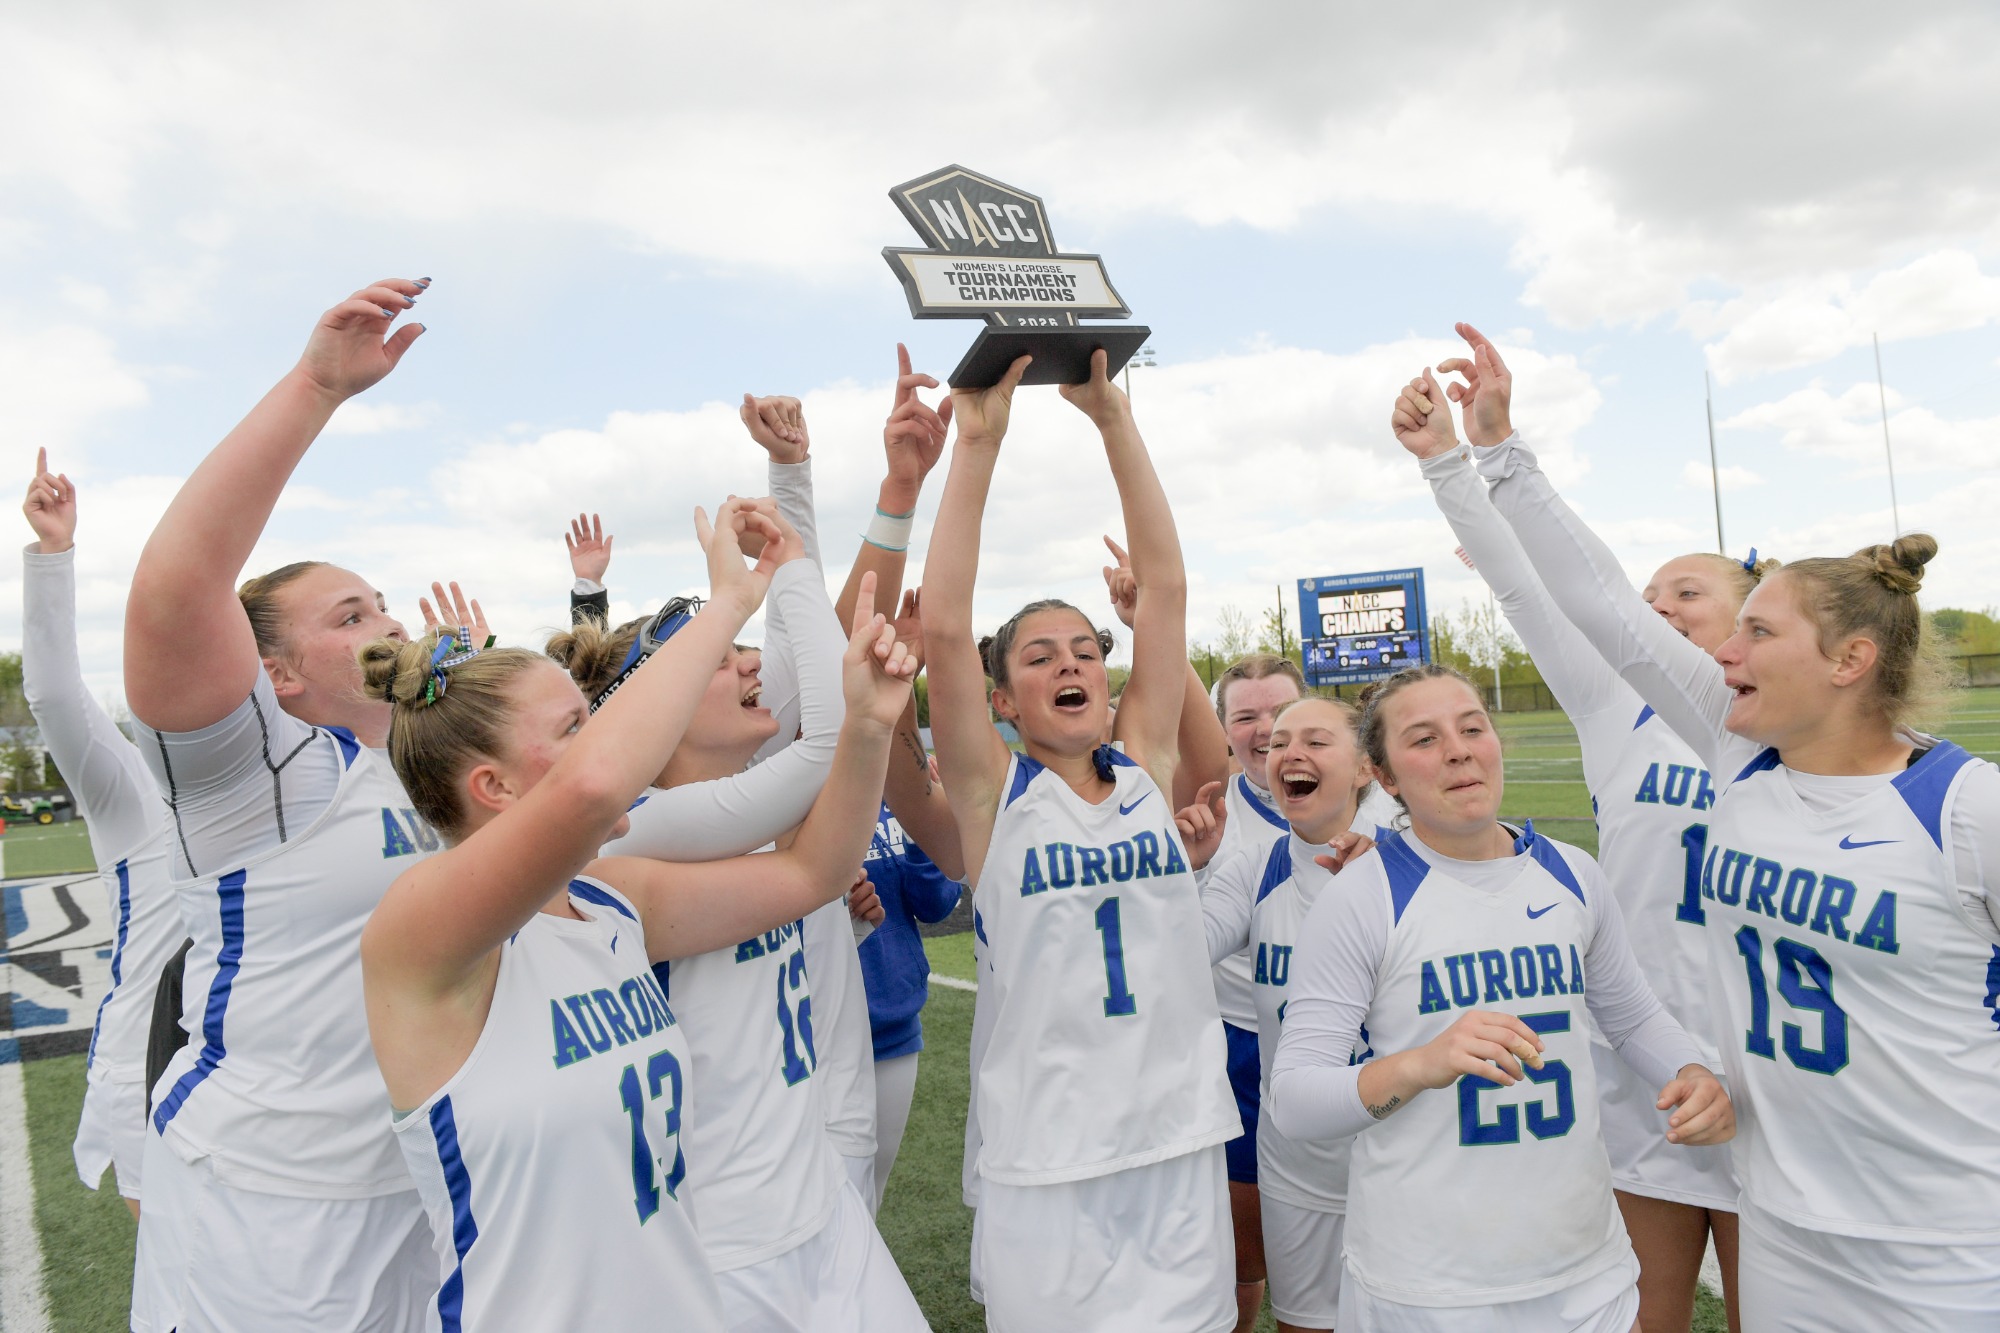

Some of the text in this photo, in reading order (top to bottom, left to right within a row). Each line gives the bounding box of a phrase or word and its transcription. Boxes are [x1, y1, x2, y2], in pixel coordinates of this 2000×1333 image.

[928, 186, 1039, 249] NACC
[943, 271, 1077, 288] TOURNAMENT
[952, 262, 1063, 274] WOMEN'S LACROSSE
[958, 286, 1076, 302] CHAMPIONS
[1323, 579, 1348, 587] AURORA
[1349, 575, 1385, 585] UNIVERSITY
[1343, 590, 1379, 612] NACC
[1322, 608, 1405, 636] CHAMPS
[1020, 828, 1187, 897] AURORA
[1702, 844, 1901, 956] AURORA
[1095, 896, 1137, 1017] 1
[1417, 943, 1585, 1015] AURORA
[1734, 924, 1850, 1076] 19
[1457, 1010, 1576, 1147] 25
[618, 1048, 686, 1227] 13
